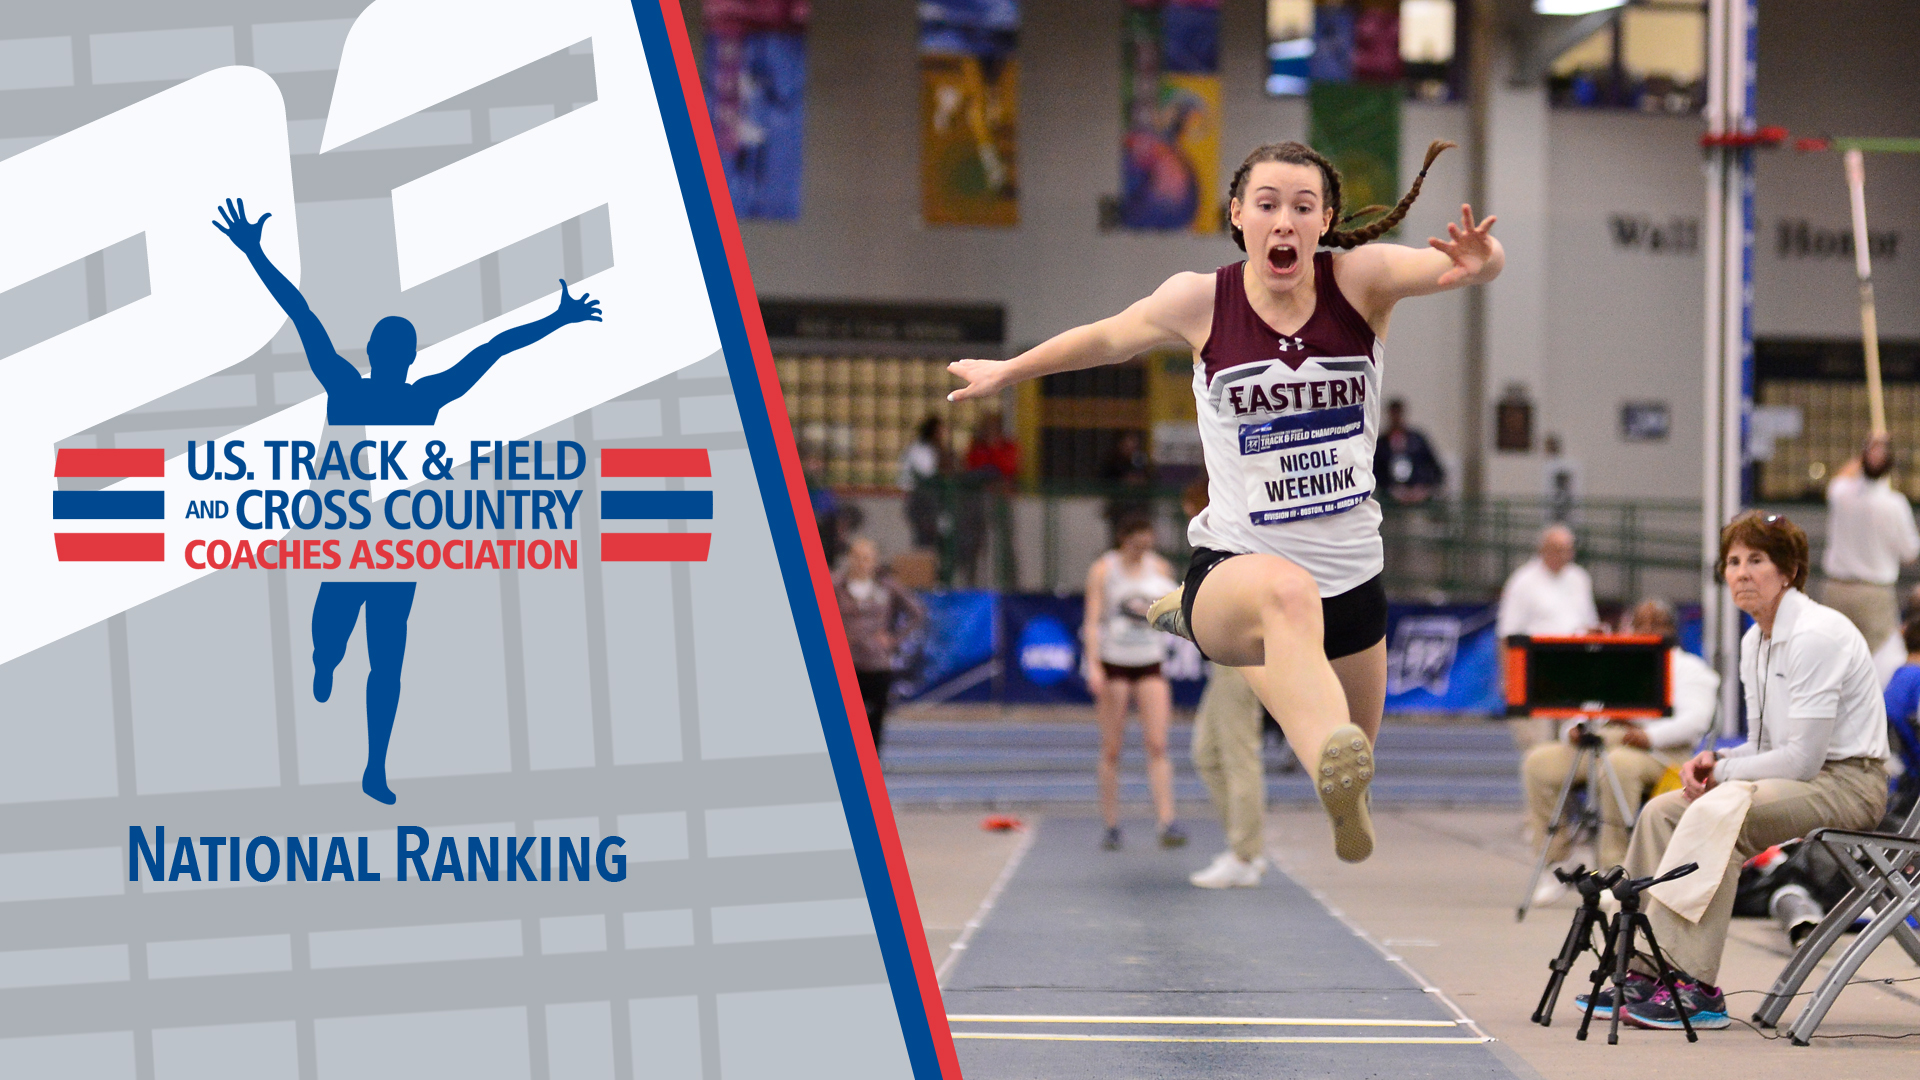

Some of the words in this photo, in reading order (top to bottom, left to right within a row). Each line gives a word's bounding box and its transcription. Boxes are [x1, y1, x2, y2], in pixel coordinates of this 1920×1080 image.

[1228, 375, 1366, 418] EASTERN
[1260, 435, 1284, 447] TRACK
[1290, 430, 1310, 442] FIELD
[1311, 421, 1362, 439] CHAMPIONSHIPS
[1279, 448, 1339, 473] NICOLE
[1265, 466, 1357, 503] WEENINK
[1263, 511, 1290, 521] DIVISION
[1336, 498, 1355, 510] MARCH
